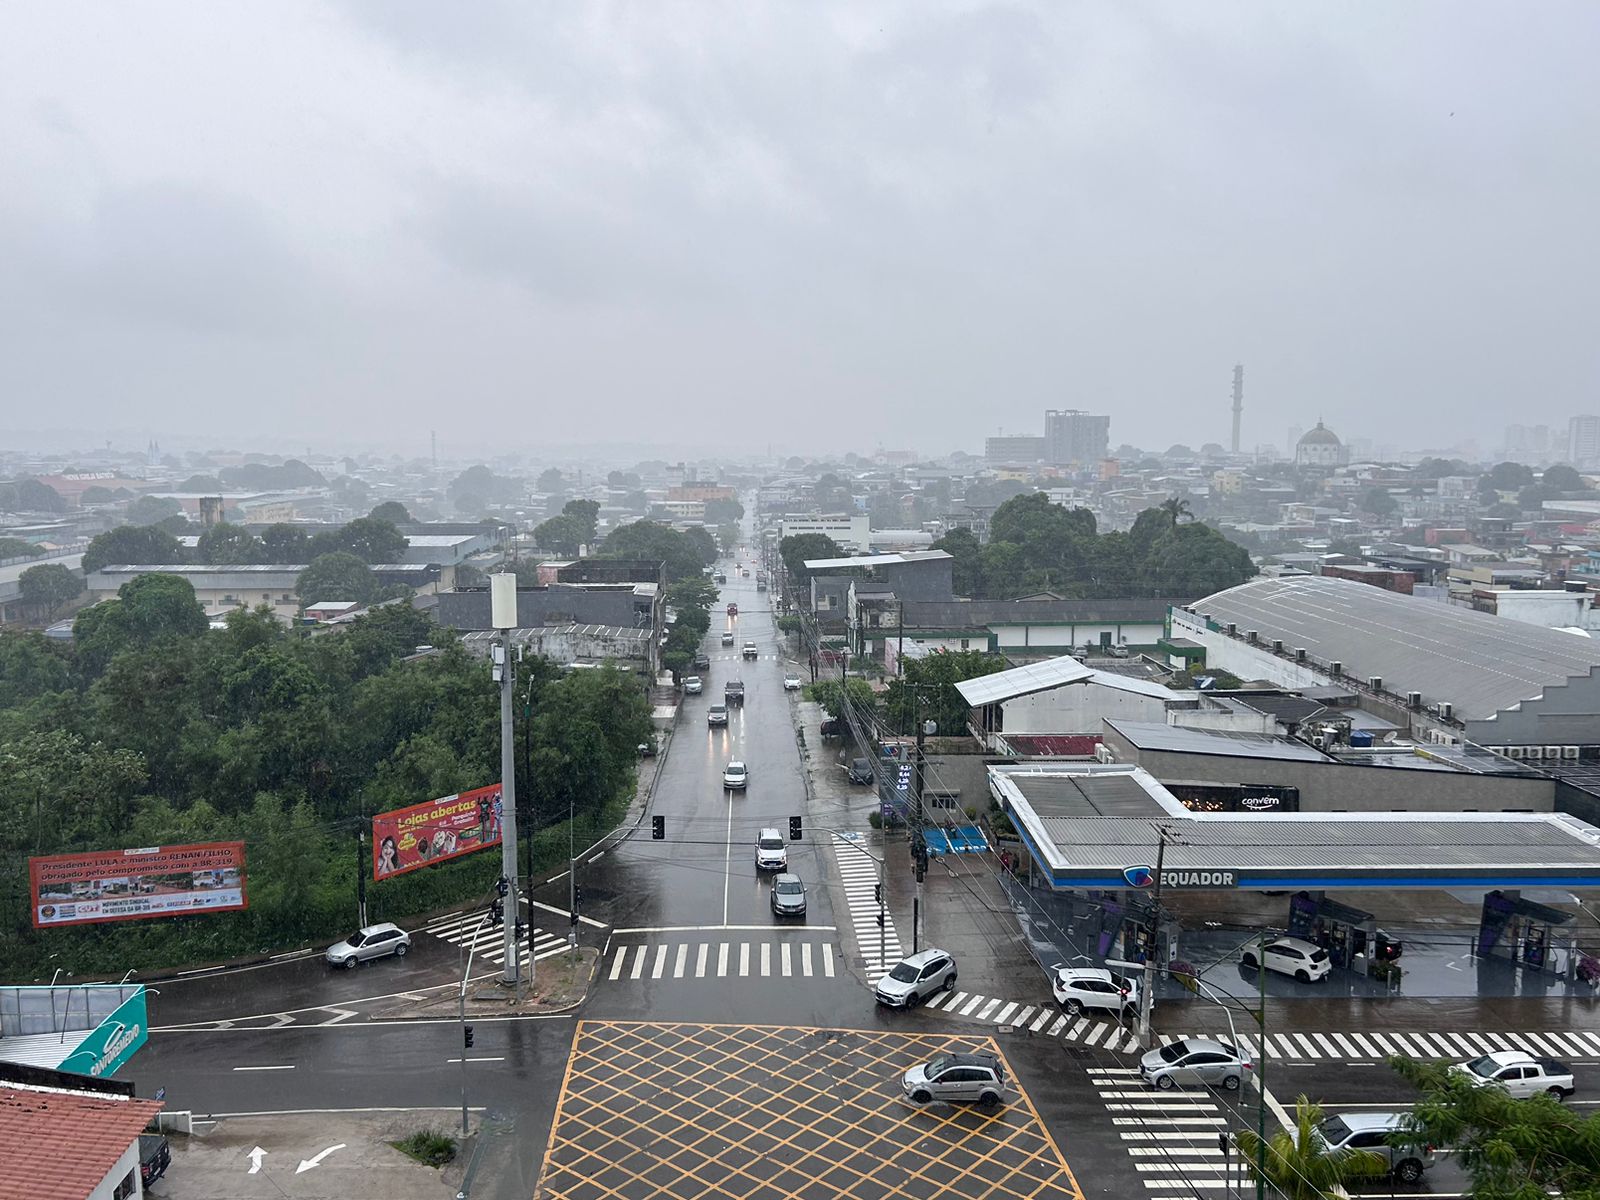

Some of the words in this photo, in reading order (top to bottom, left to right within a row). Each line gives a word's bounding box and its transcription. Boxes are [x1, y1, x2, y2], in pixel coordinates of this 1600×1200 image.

[397, 812, 429, 829] Lojas
[430, 799, 477, 819] abertas
[41, 871, 83, 881] obrigado
[85, 868, 106, 877] pelo
[108, 864, 169, 875] compromisso
[200, 858, 233, 867] BR-319
[42, 861, 92, 871] Presidente
[95, 858, 118, 866] LULA
[130, 855, 167, 863] ministro
[167, 851, 200, 860] RENAN
[203, 849, 233, 858] FILHO,
[1160, 872, 1233, 887] EQUADOR
[102, 900, 128, 908] MOVIMENTO
